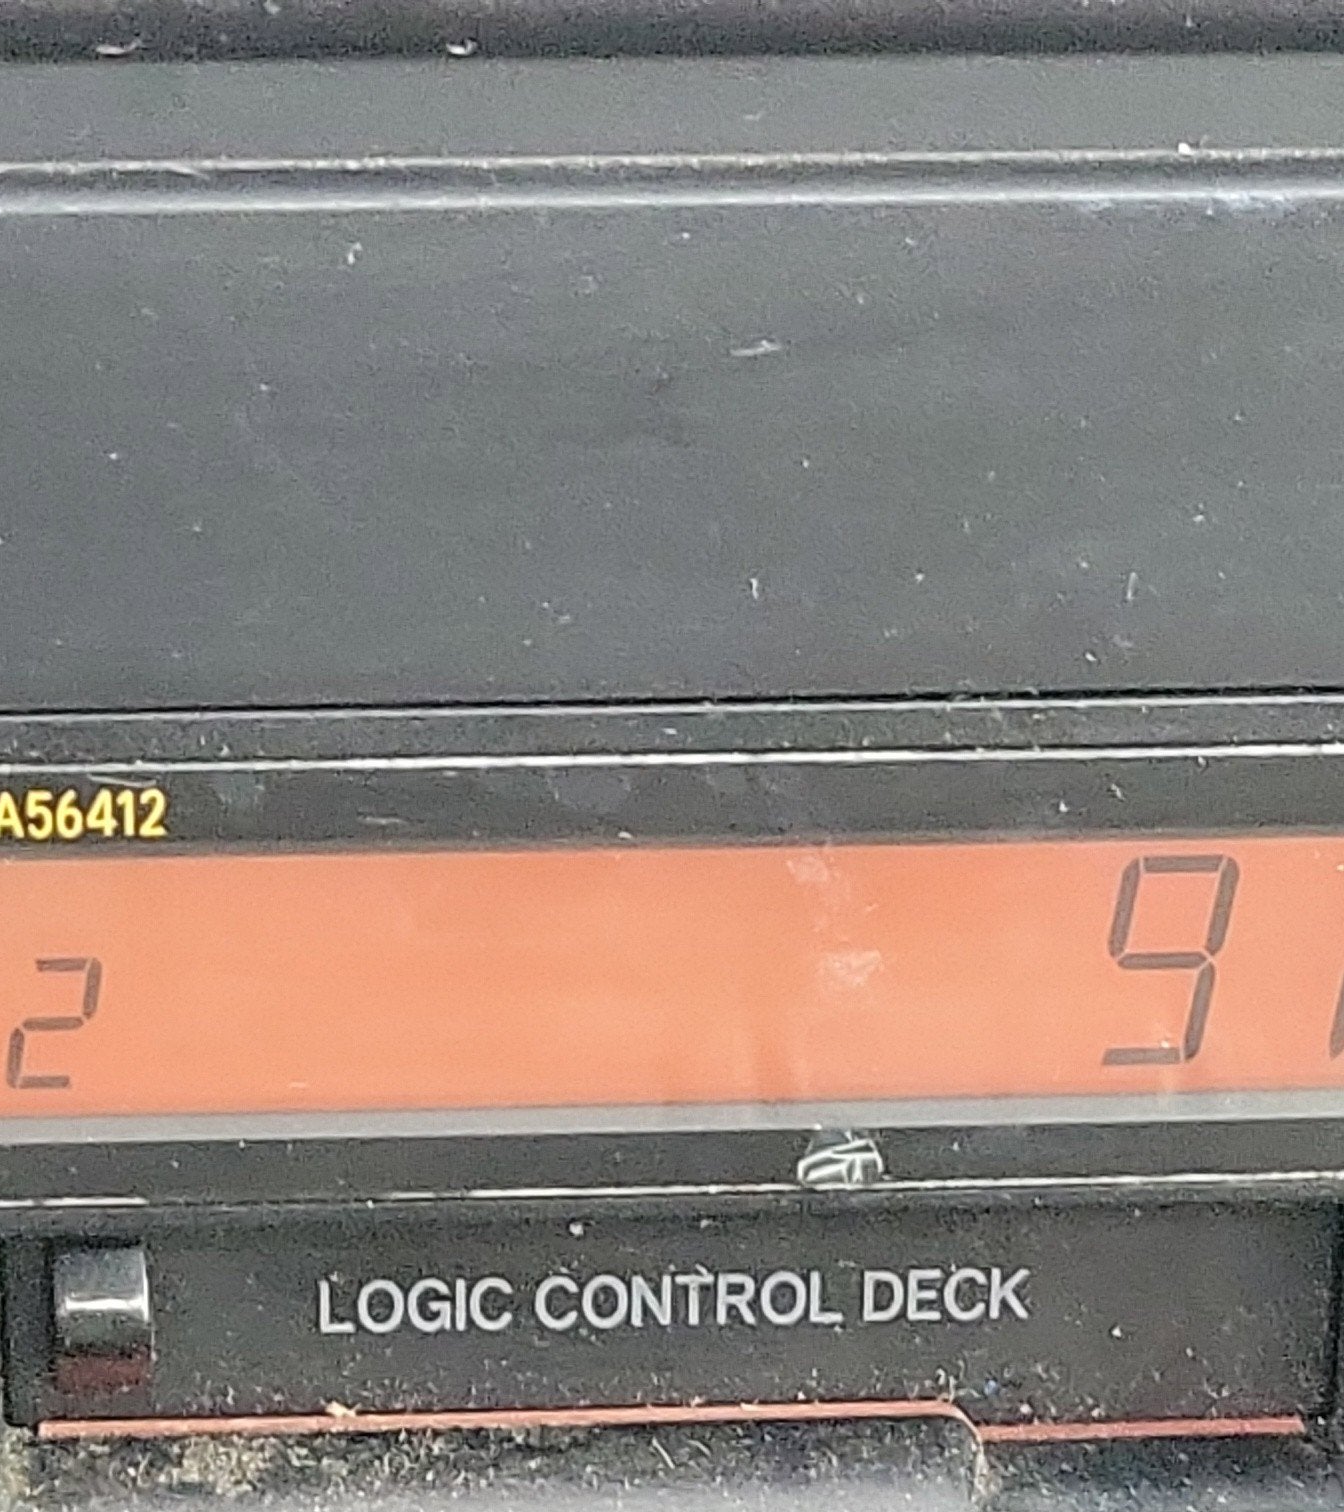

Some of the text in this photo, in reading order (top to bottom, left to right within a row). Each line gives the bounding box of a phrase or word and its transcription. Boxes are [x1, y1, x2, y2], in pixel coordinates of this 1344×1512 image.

[7, 957, 103, 1089] 2
[316, 1267, 1032, 1334] LOGIC CONTROL DECK
